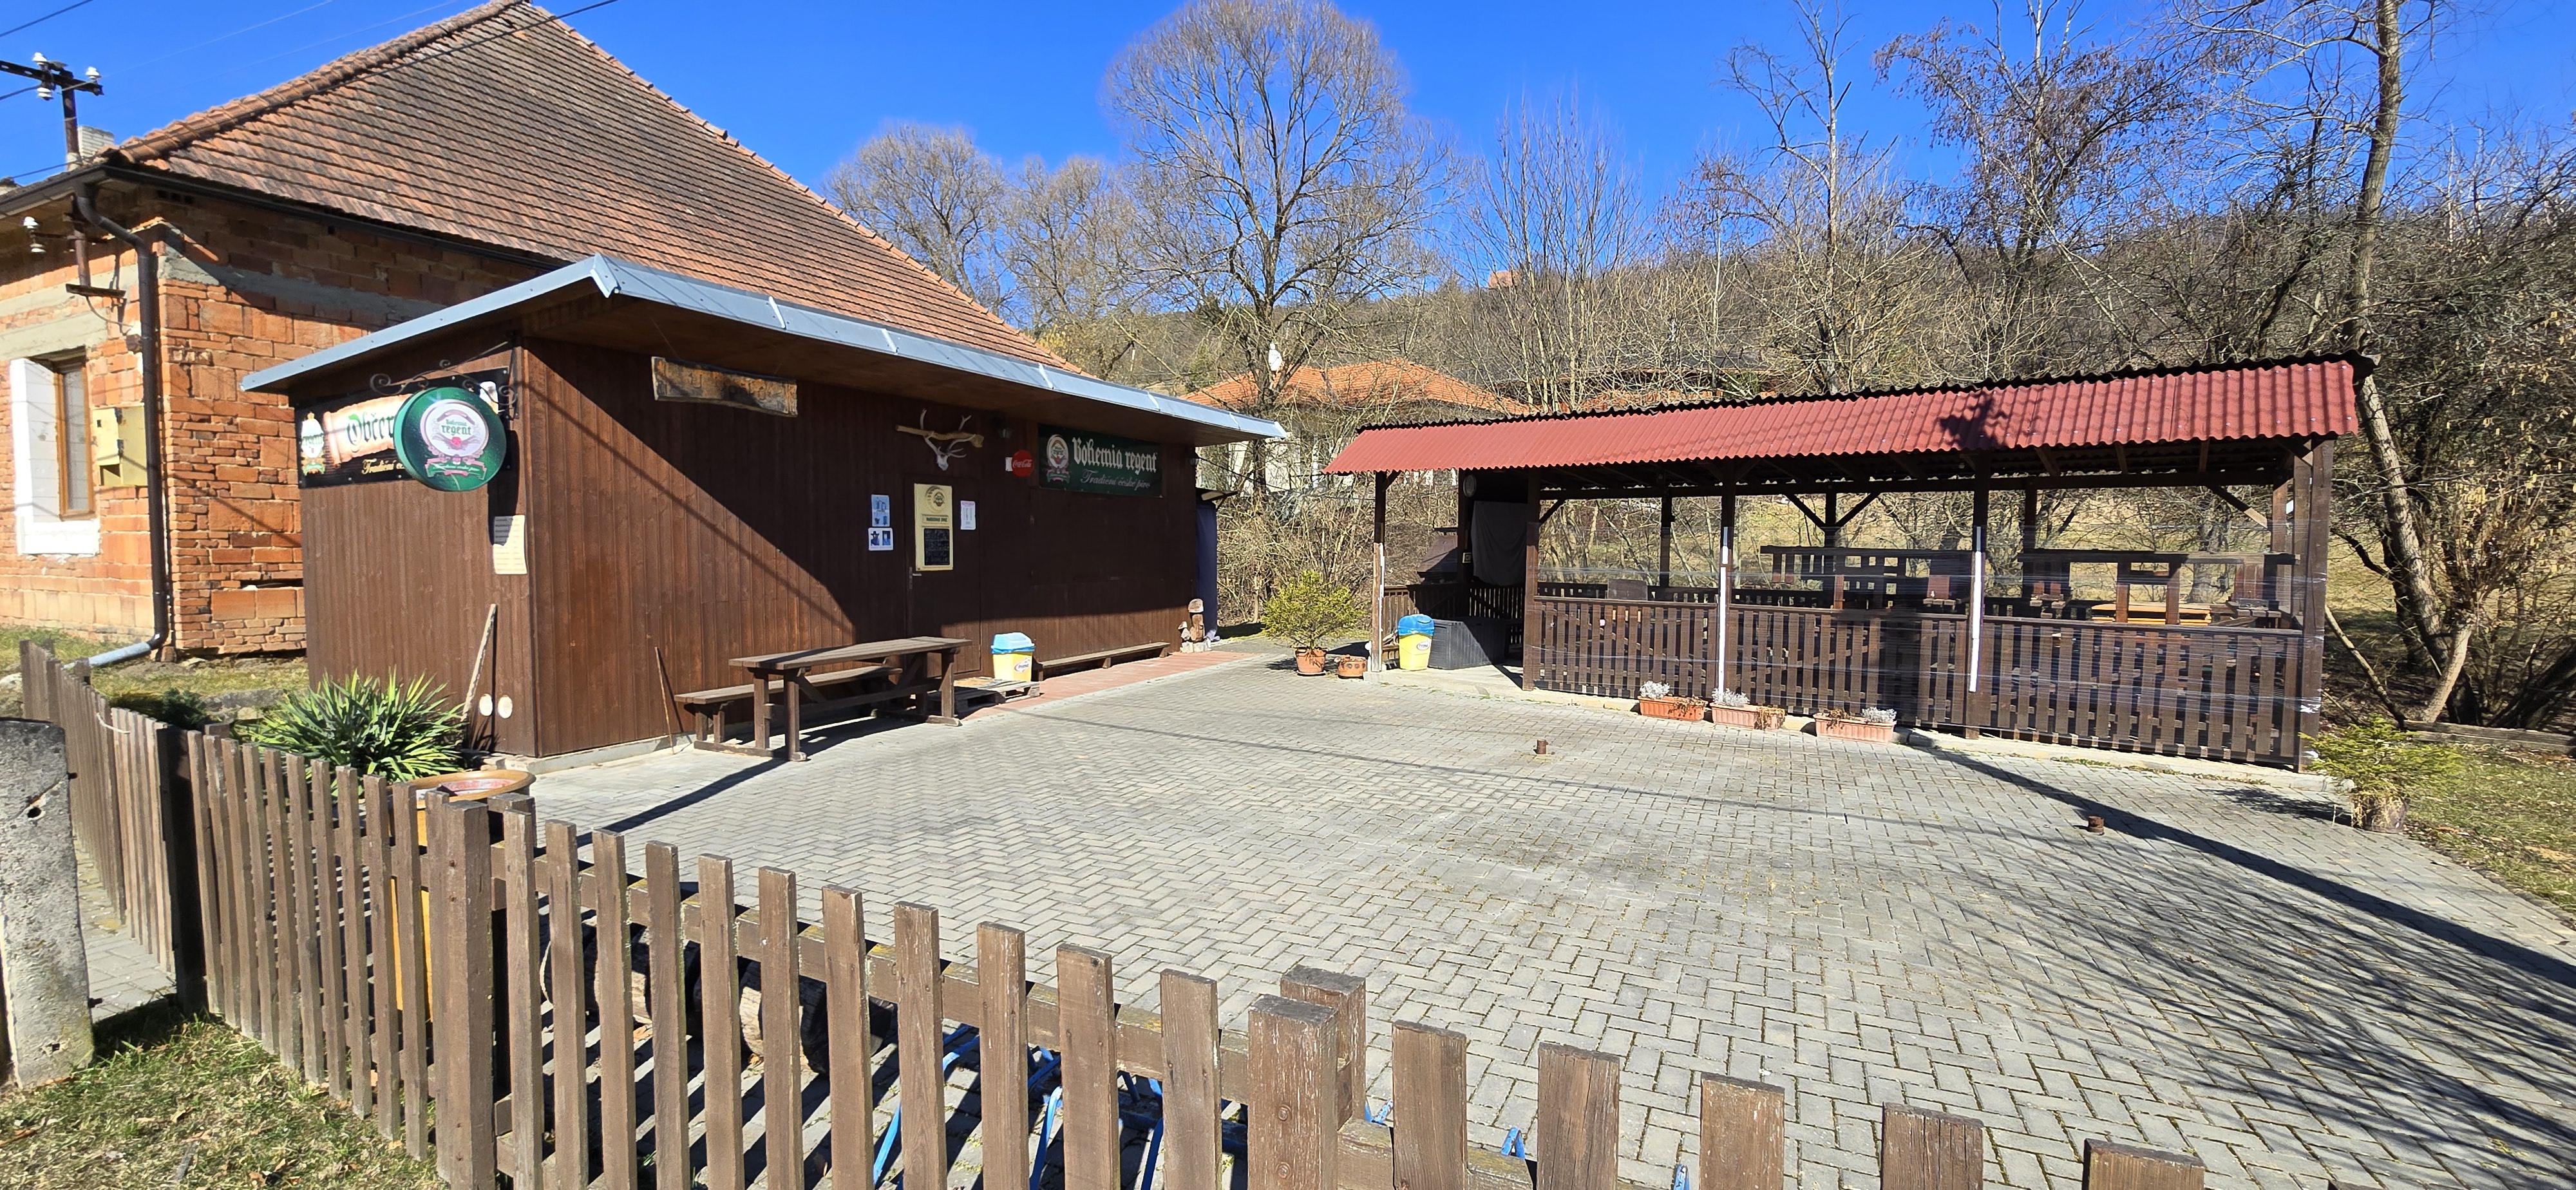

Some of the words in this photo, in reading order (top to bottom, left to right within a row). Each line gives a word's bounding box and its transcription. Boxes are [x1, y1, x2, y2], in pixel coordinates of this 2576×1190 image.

[346, 411, 395, 453] Občer
[440, 424, 471, 436] regent
[1012, 458, 1033, 469] Coca-Cola
[1072, 437, 1124, 469] Bohemia
[1125, 451, 1158, 475] regent
[1080, 469, 1117, 486] Tradiční
[1133, 479, 1151, 491] pivo
